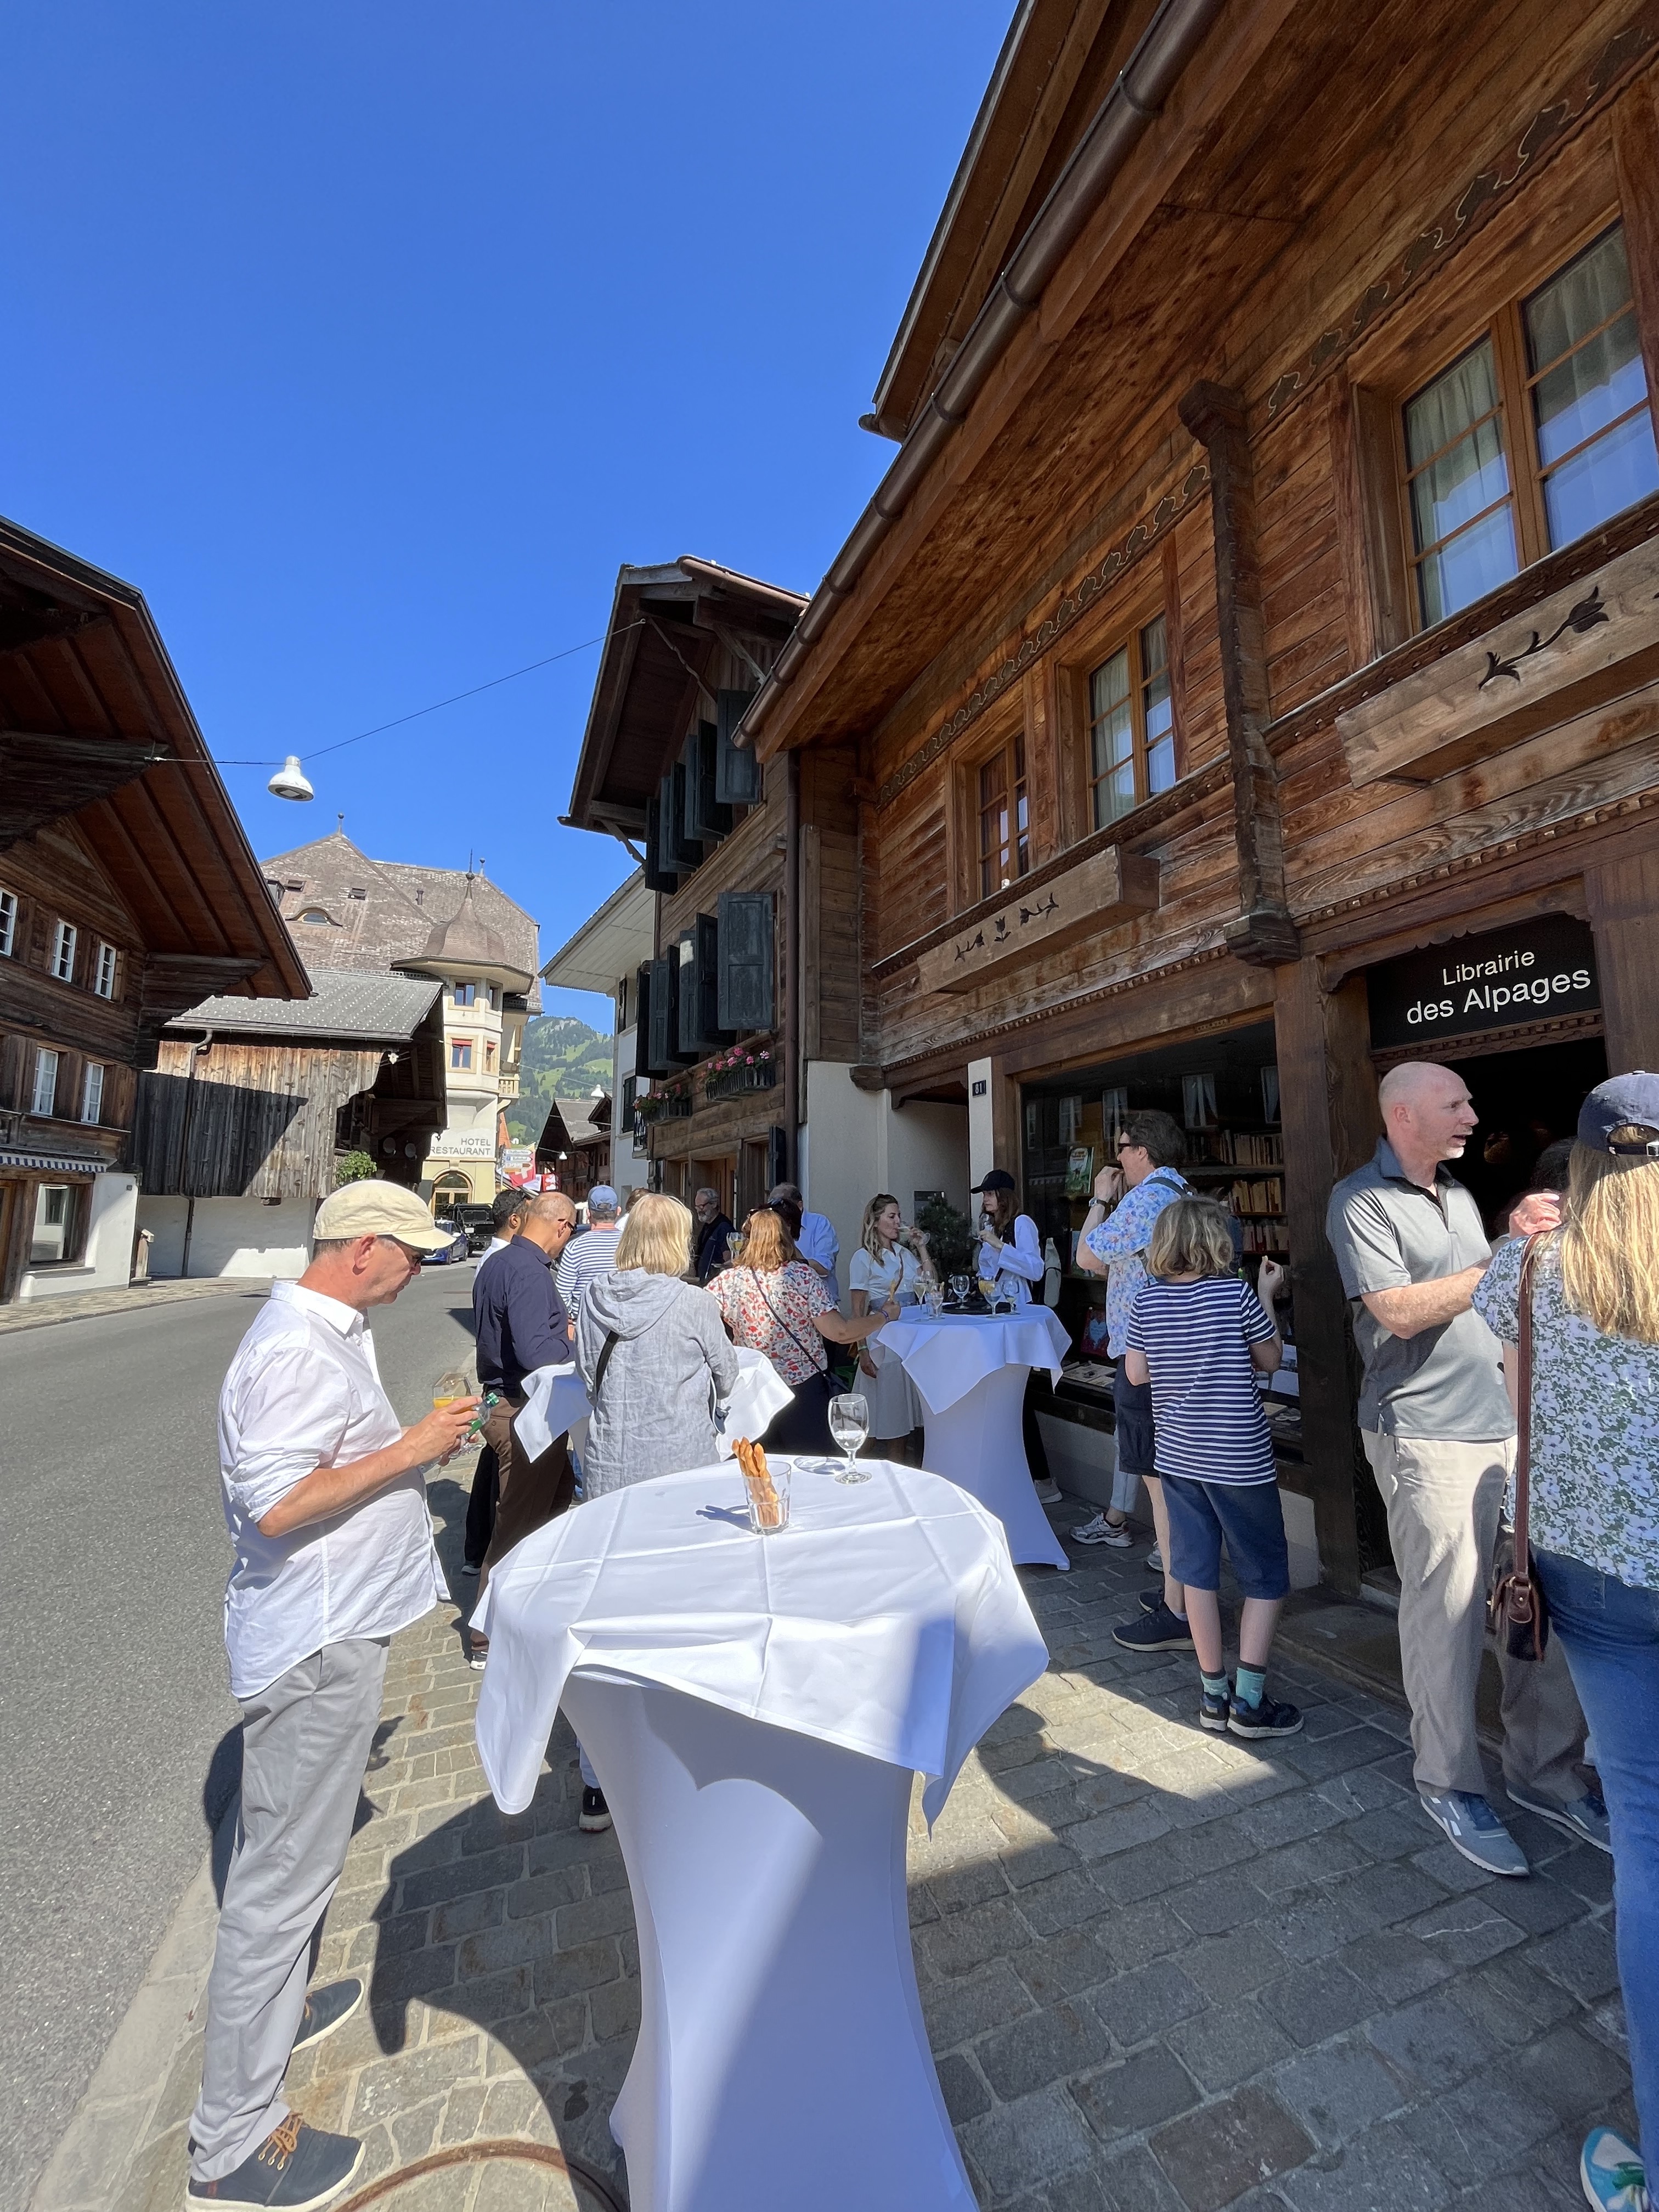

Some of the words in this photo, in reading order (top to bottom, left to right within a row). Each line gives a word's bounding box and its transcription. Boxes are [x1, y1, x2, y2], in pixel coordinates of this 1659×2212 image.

[1443, 950, 1535, 985] Librairie
[1407, 1001, 1454, 1024] des
[1463, 969, 1591, 1013] Alpages
[975, 1082, 982, 1094] 81
[461, 1138, 490, 1146] HOTEL
[430, 1147, 490, 1155] RESTAURANT
